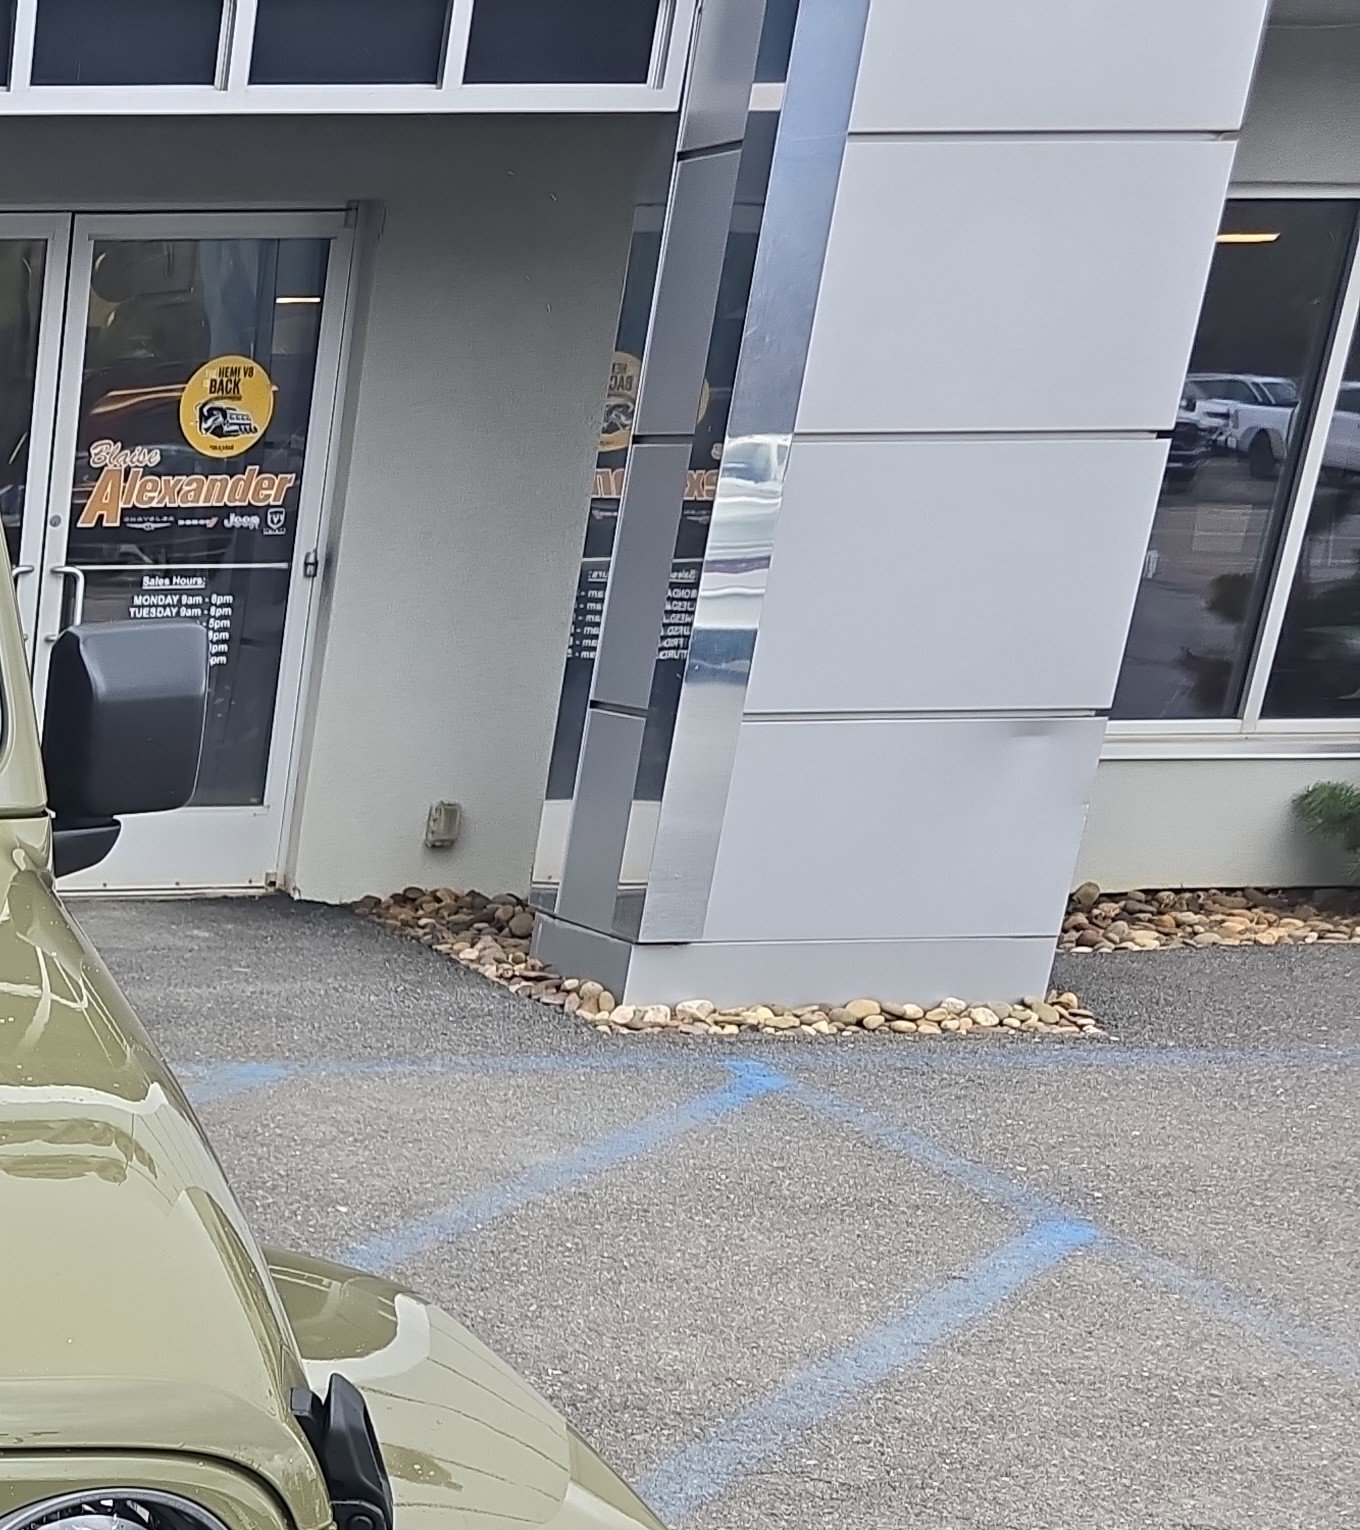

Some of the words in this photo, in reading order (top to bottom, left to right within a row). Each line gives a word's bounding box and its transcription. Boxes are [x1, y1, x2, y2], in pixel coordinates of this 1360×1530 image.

[218, 366, 241, 378] HEMI
[243, 366, 254, 378] V8
[209, 378, 241, 395] BACK
[89, 439, 162, 468] Blaise
[76, 464, 296, 528] Alexander
[142, 576, 170, 587] Sales
[172, 575, 206, 587] Hours:
[133, 594, 180, 605] MONDAY
[128, 606, 178, 618] TUESDAY
[209, 655, 227, 667] pm
